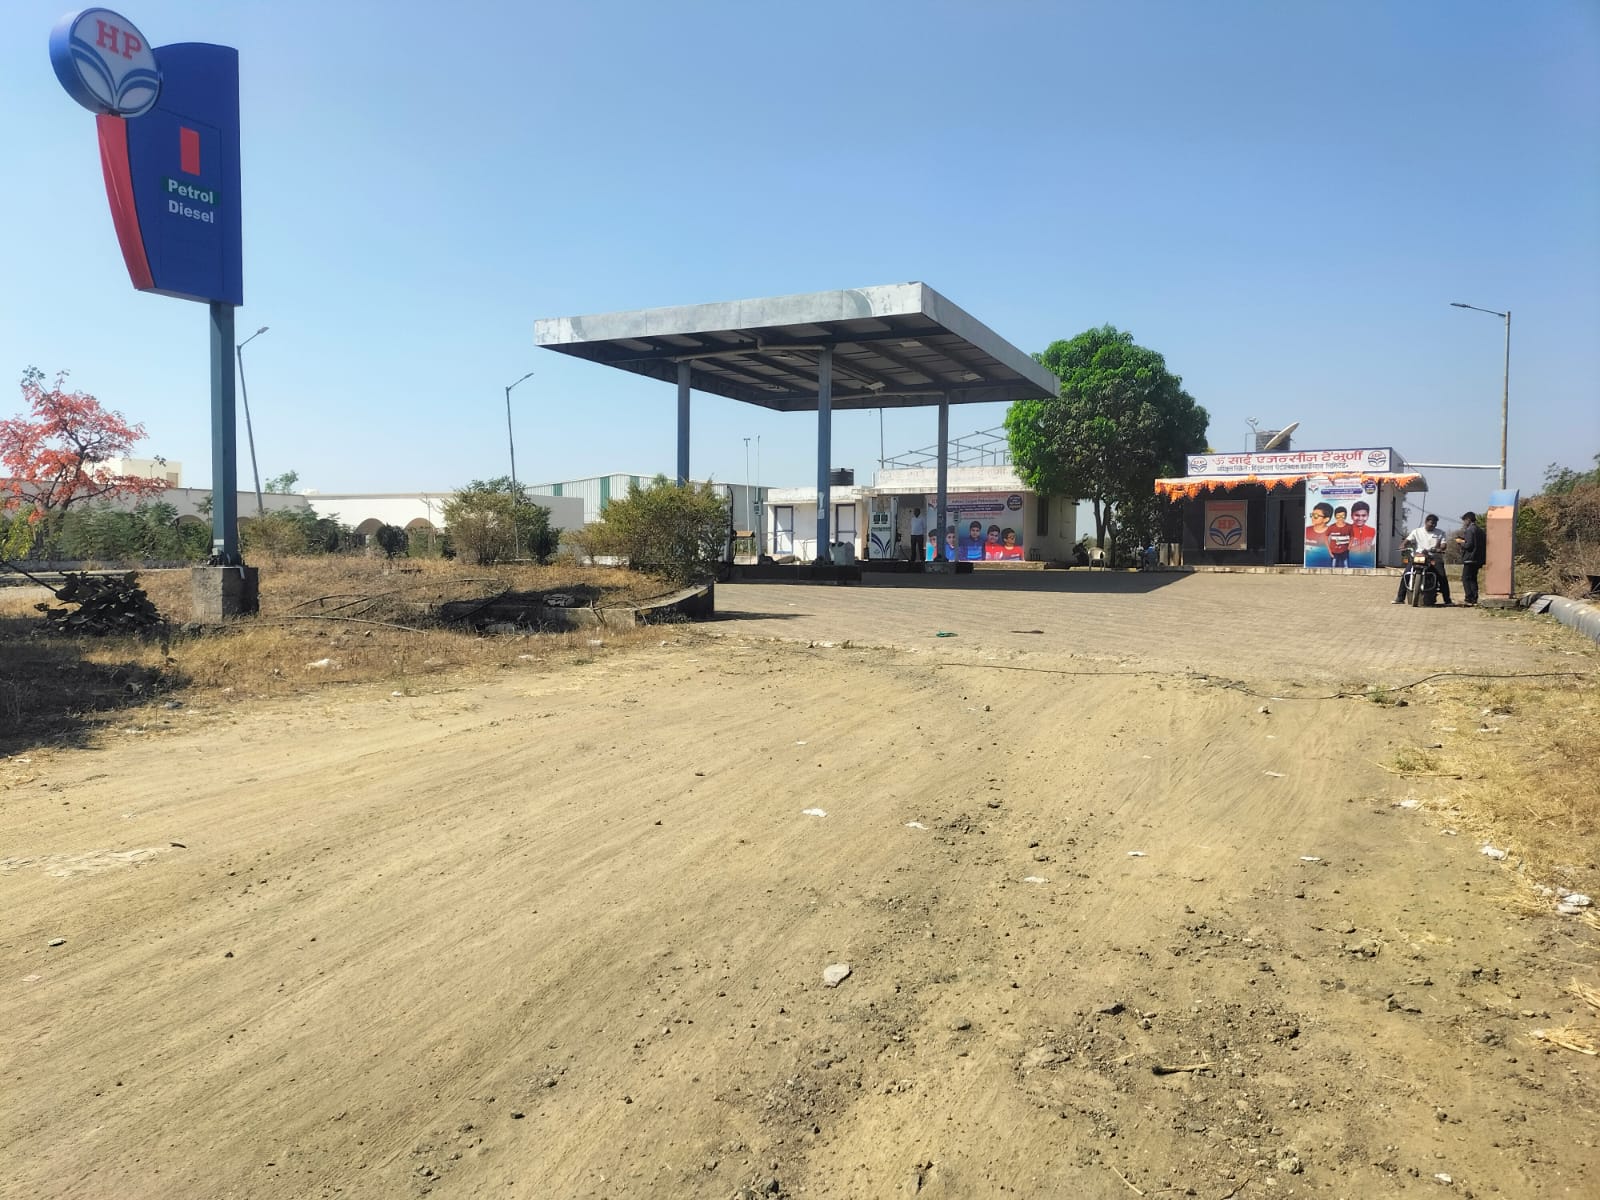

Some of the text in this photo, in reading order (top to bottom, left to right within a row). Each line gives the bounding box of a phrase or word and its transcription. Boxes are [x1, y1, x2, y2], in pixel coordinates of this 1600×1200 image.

[95, 20, 142, 60] HP
[167, 178, 214, 205] Petrol
[167, 199, 214, 224] Diesel
[1228, 453, 1252, 466] साई
[1218, 519, 1236, 530] HP
